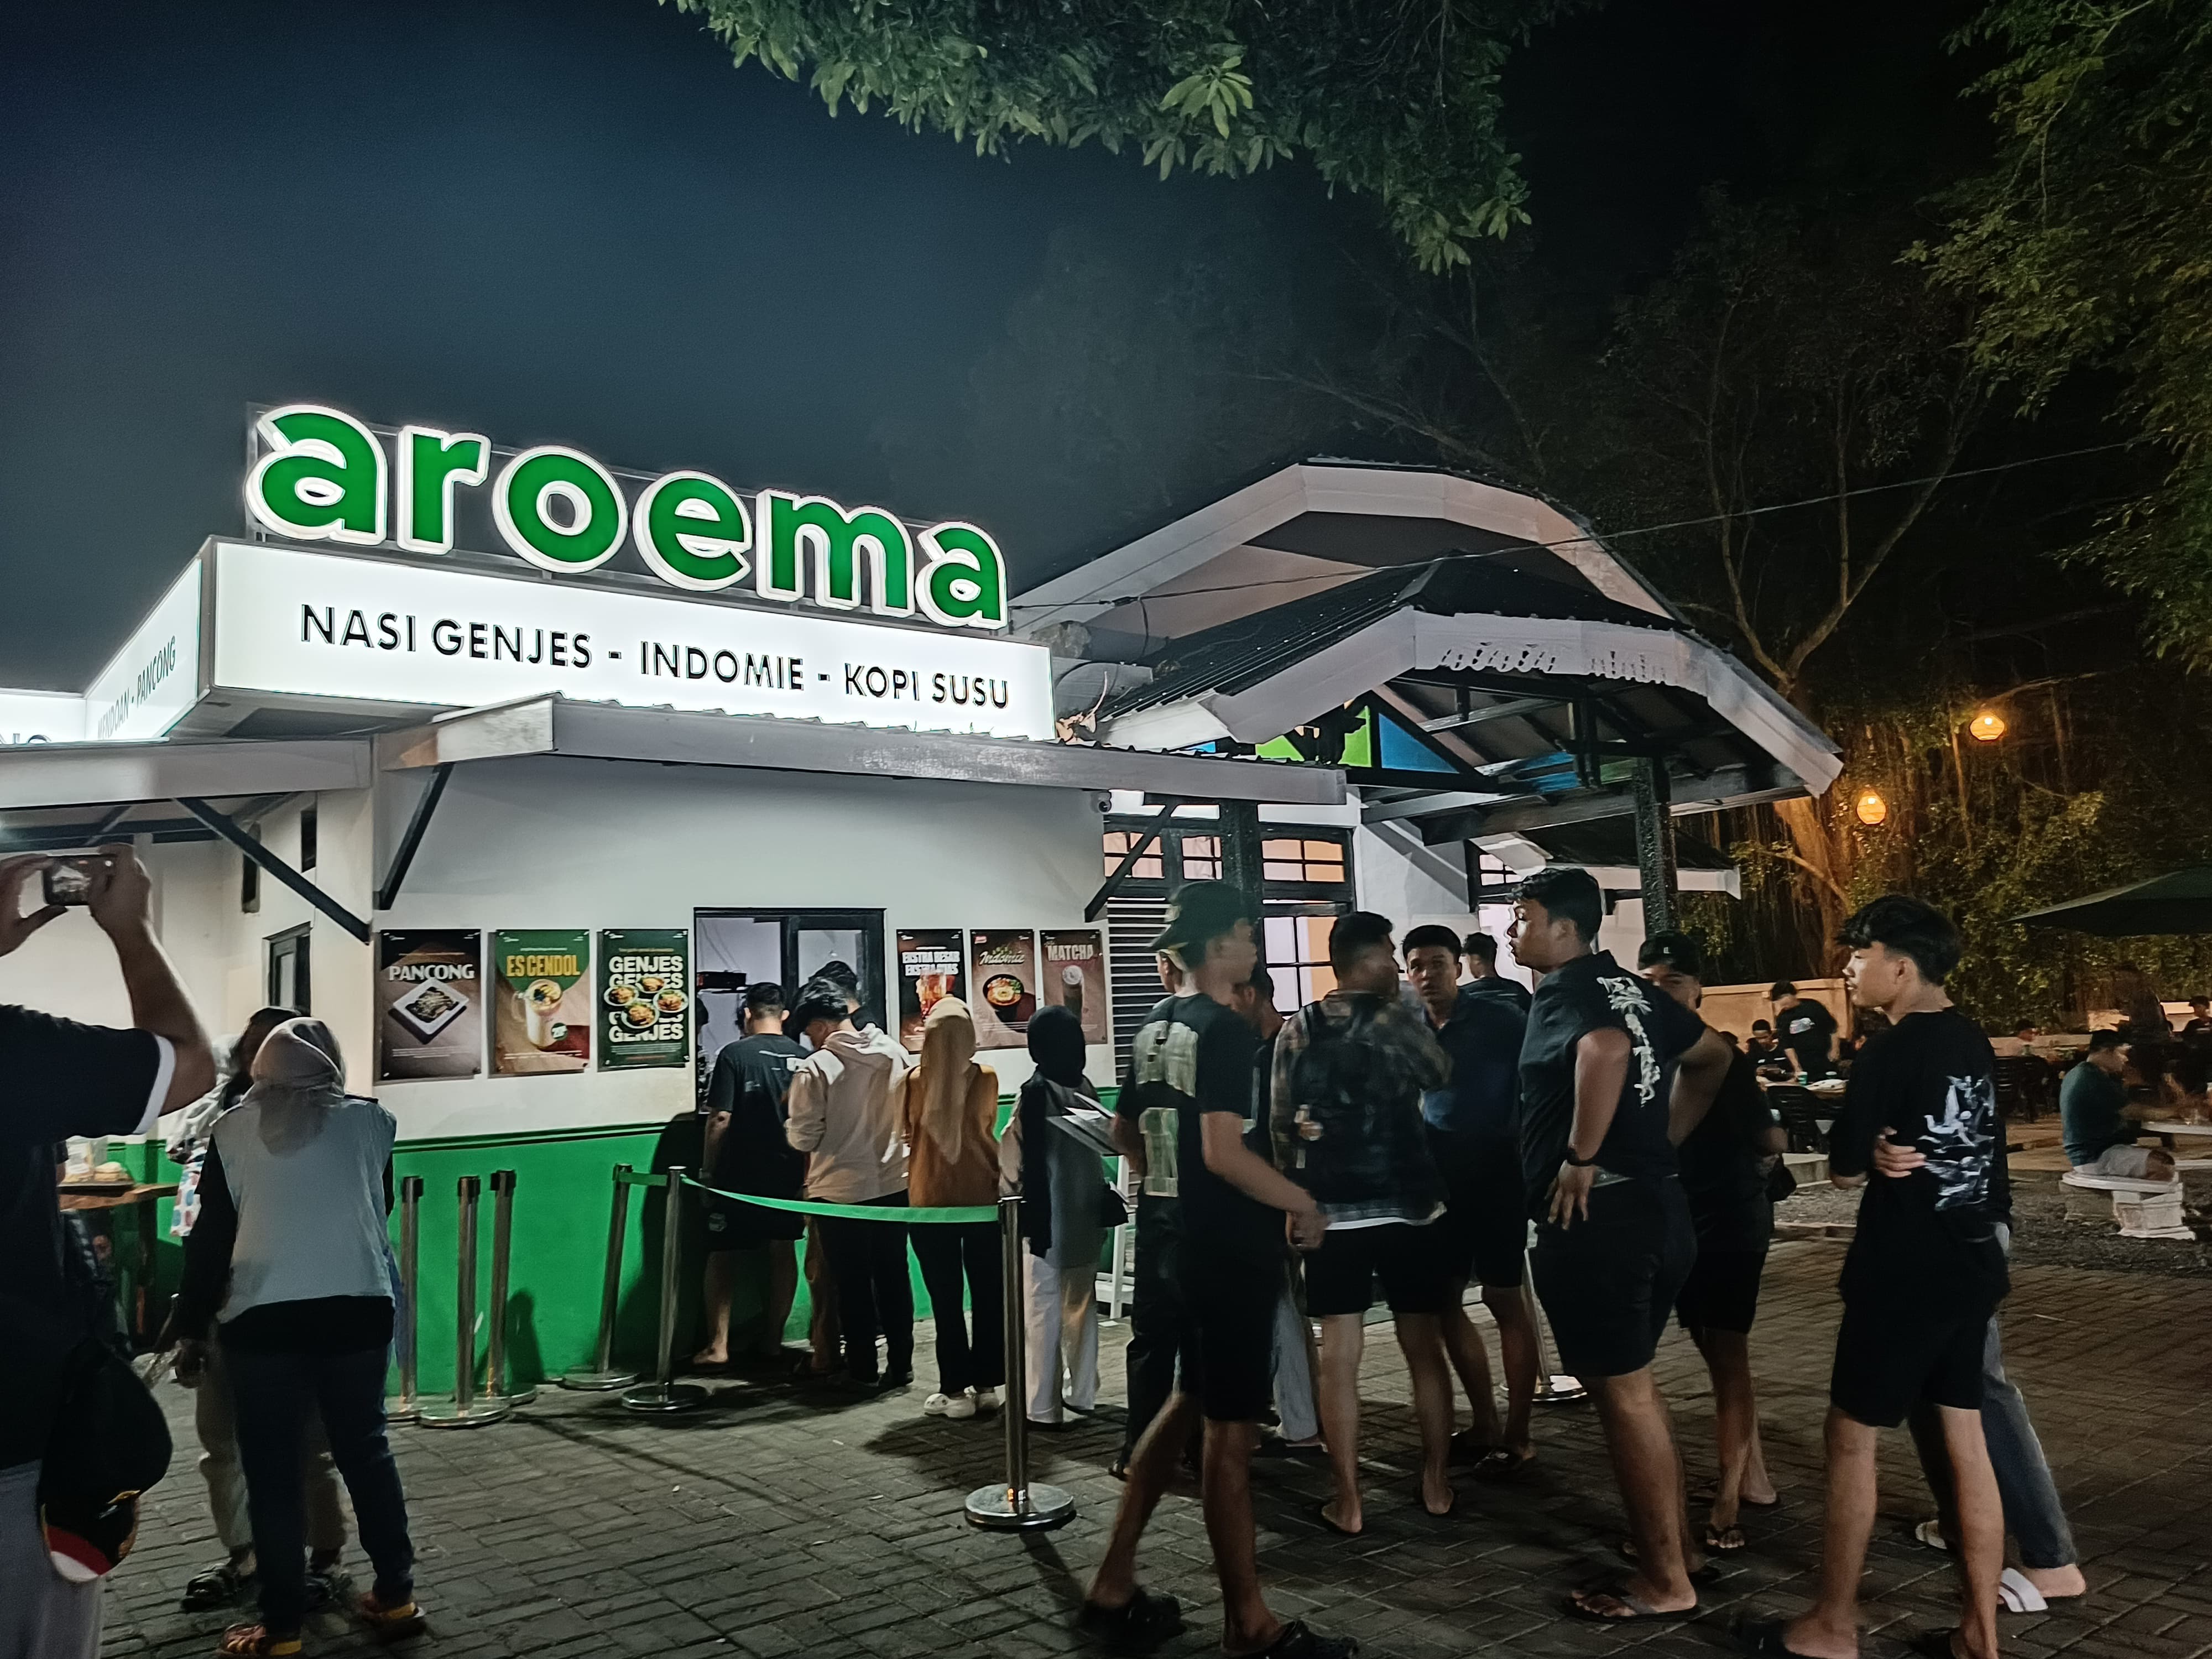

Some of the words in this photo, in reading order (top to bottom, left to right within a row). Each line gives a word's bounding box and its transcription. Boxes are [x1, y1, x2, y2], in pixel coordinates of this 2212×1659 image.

[244, 404, 1009, 630] aroema
[301, 604, 416, 652] NASI
[431, 618, 593, 668] GENJES
[640, 641, 804, 691] INDOMIE
[844, 663, 920, 701] KOPI
[932, 672, 1009, 709] SUSU
[137, 635, 175, 708] PANCONG
[1048, 944, 1093, 961] MATCHA
[389, 964, 475, 980] PANCONG
[506, 955, 525, 977] ES
[526, 954, 581, 976] CENDOL
[609, 956, 684, 973] GENJES
